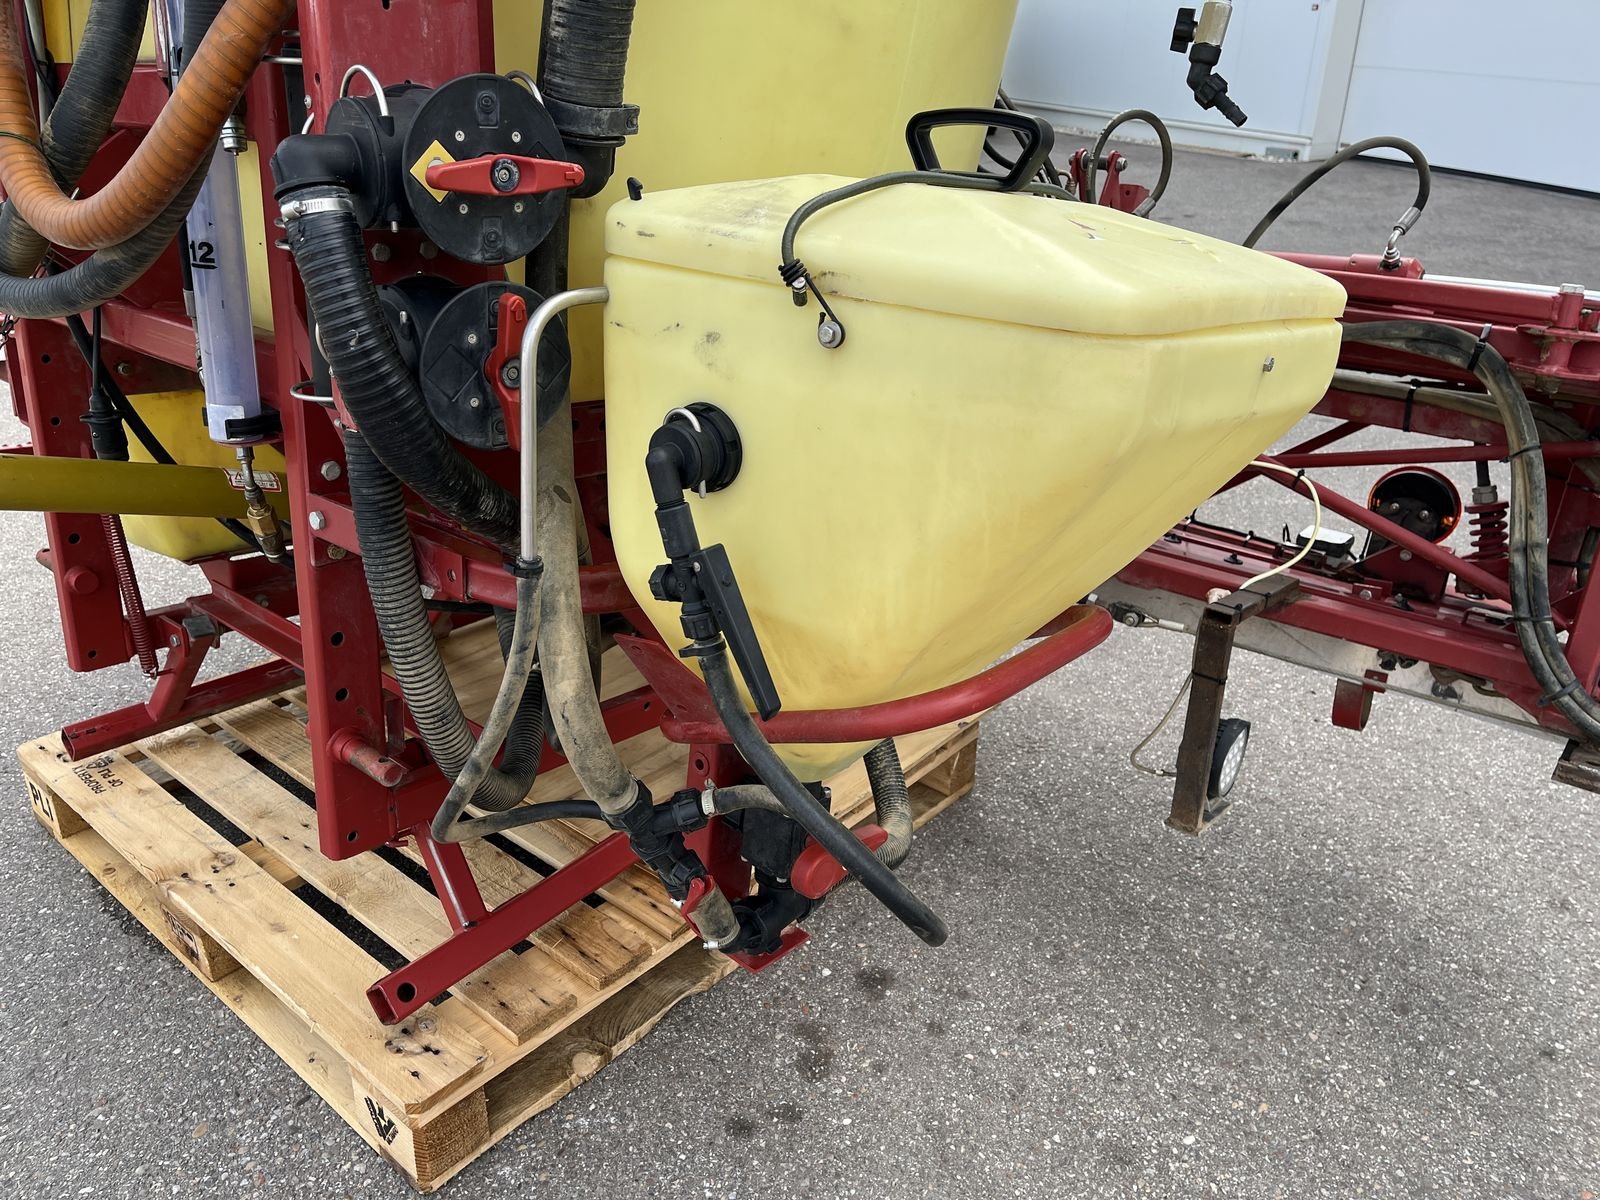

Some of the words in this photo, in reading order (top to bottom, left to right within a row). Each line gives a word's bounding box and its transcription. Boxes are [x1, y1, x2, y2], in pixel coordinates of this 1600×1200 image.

[190, 240, 215, 263] 12
[72, 765, 106, 794] PROPERTY
[107, 778, 123, 787] OF
